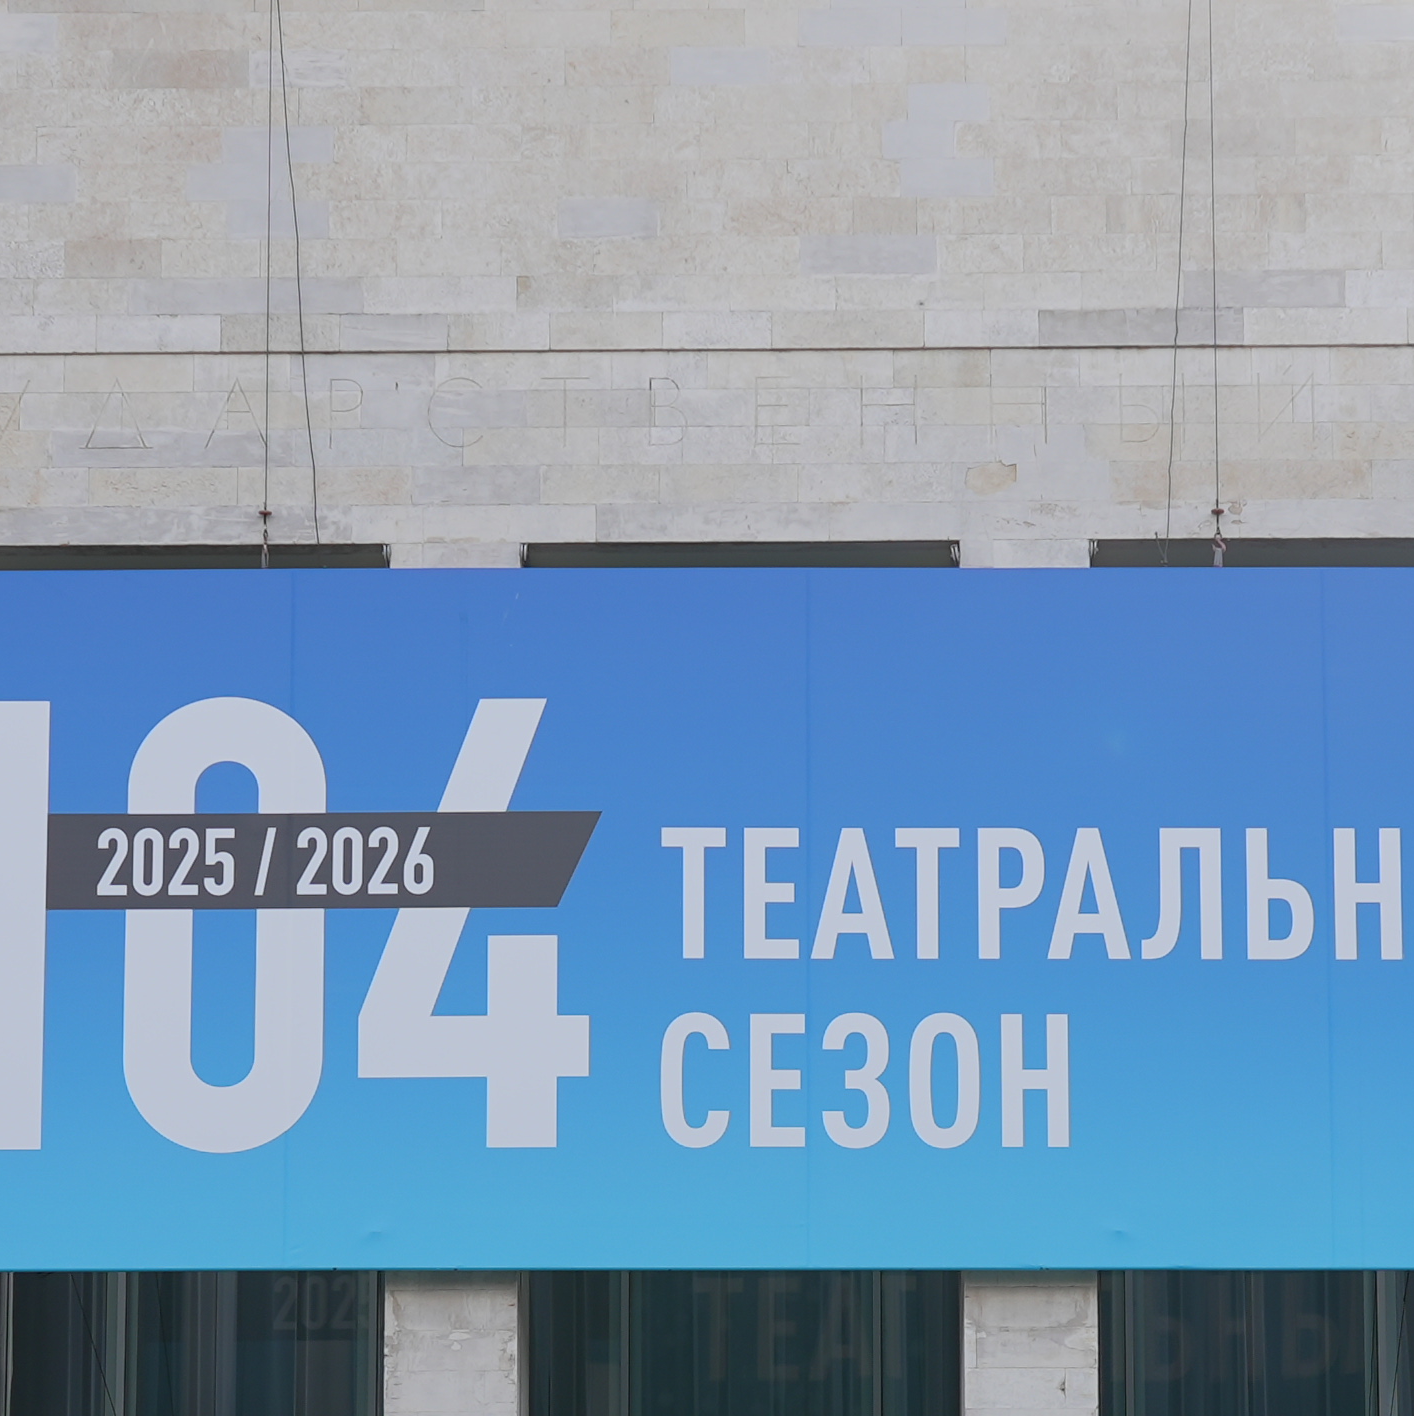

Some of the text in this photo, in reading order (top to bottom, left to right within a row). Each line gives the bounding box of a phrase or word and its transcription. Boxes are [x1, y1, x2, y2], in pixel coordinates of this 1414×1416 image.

[96, 827, 235, 896] 2025
[296, 826, 434, 895] 2026
[660, 1012, 1070, 1149] СЕЗОН
